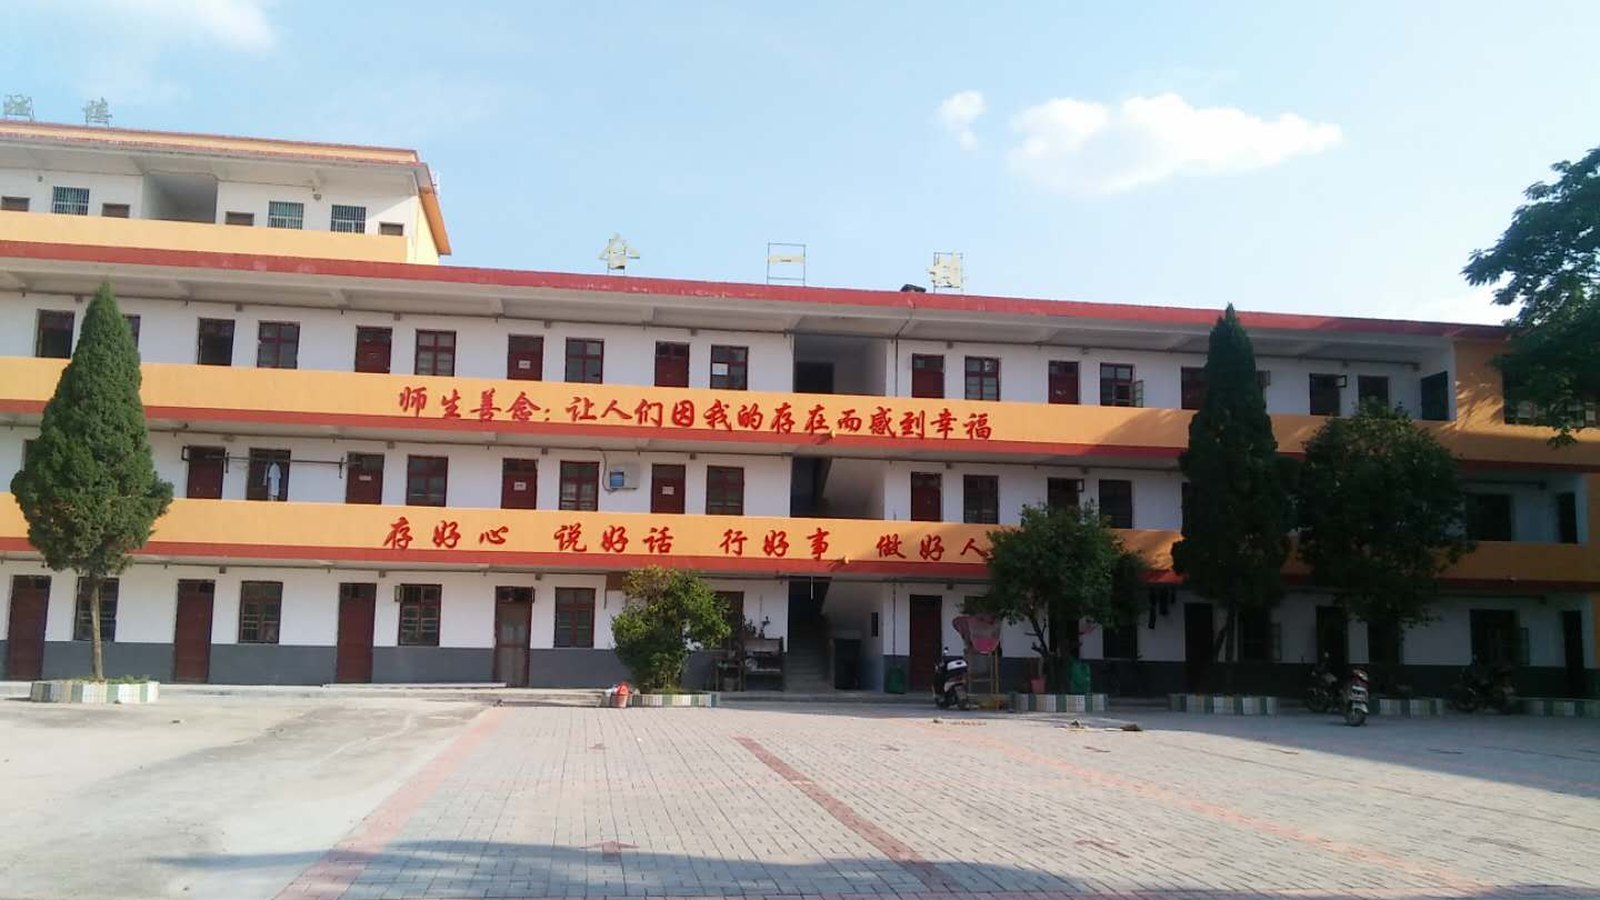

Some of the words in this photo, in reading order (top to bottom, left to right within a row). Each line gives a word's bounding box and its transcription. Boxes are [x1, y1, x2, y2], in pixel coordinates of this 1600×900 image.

[382, 517, 508, 550] 存好心
[554, 523, 675, 555] 说好话
[720, 528, 830, 561] 行好事
[876, 533, 990, 561] 做好人
